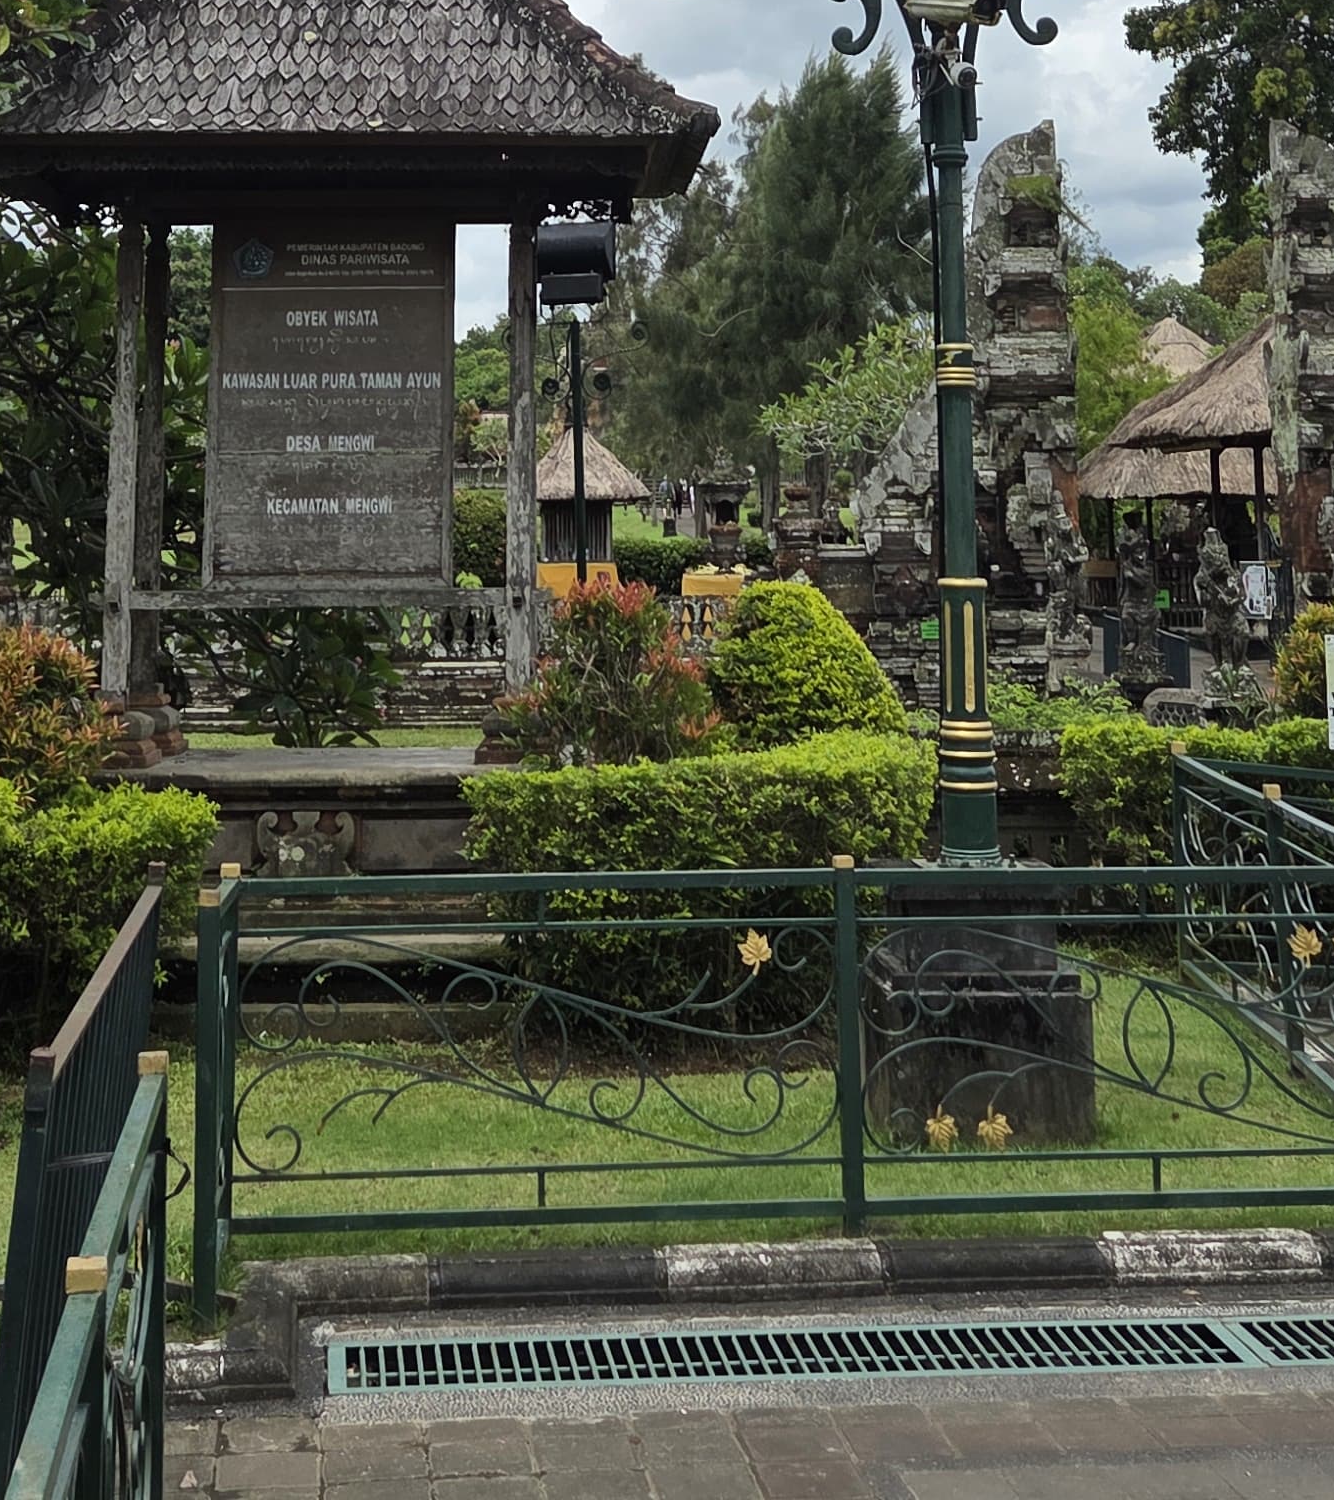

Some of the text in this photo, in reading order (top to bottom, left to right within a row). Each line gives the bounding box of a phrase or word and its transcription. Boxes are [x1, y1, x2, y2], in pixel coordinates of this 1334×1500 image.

[301, 253, 410, 266] DINAS PARIWISATA
[286, 309, 379, 326] OBYEK WISATA
[222, 372, 441, 389] KAWASAN LUAR PURA TAMAN AYUN
[286, 435, 375, 451] DESA MENGWI
[267, 497, 392, 514] KECAMATAN MENGWI
